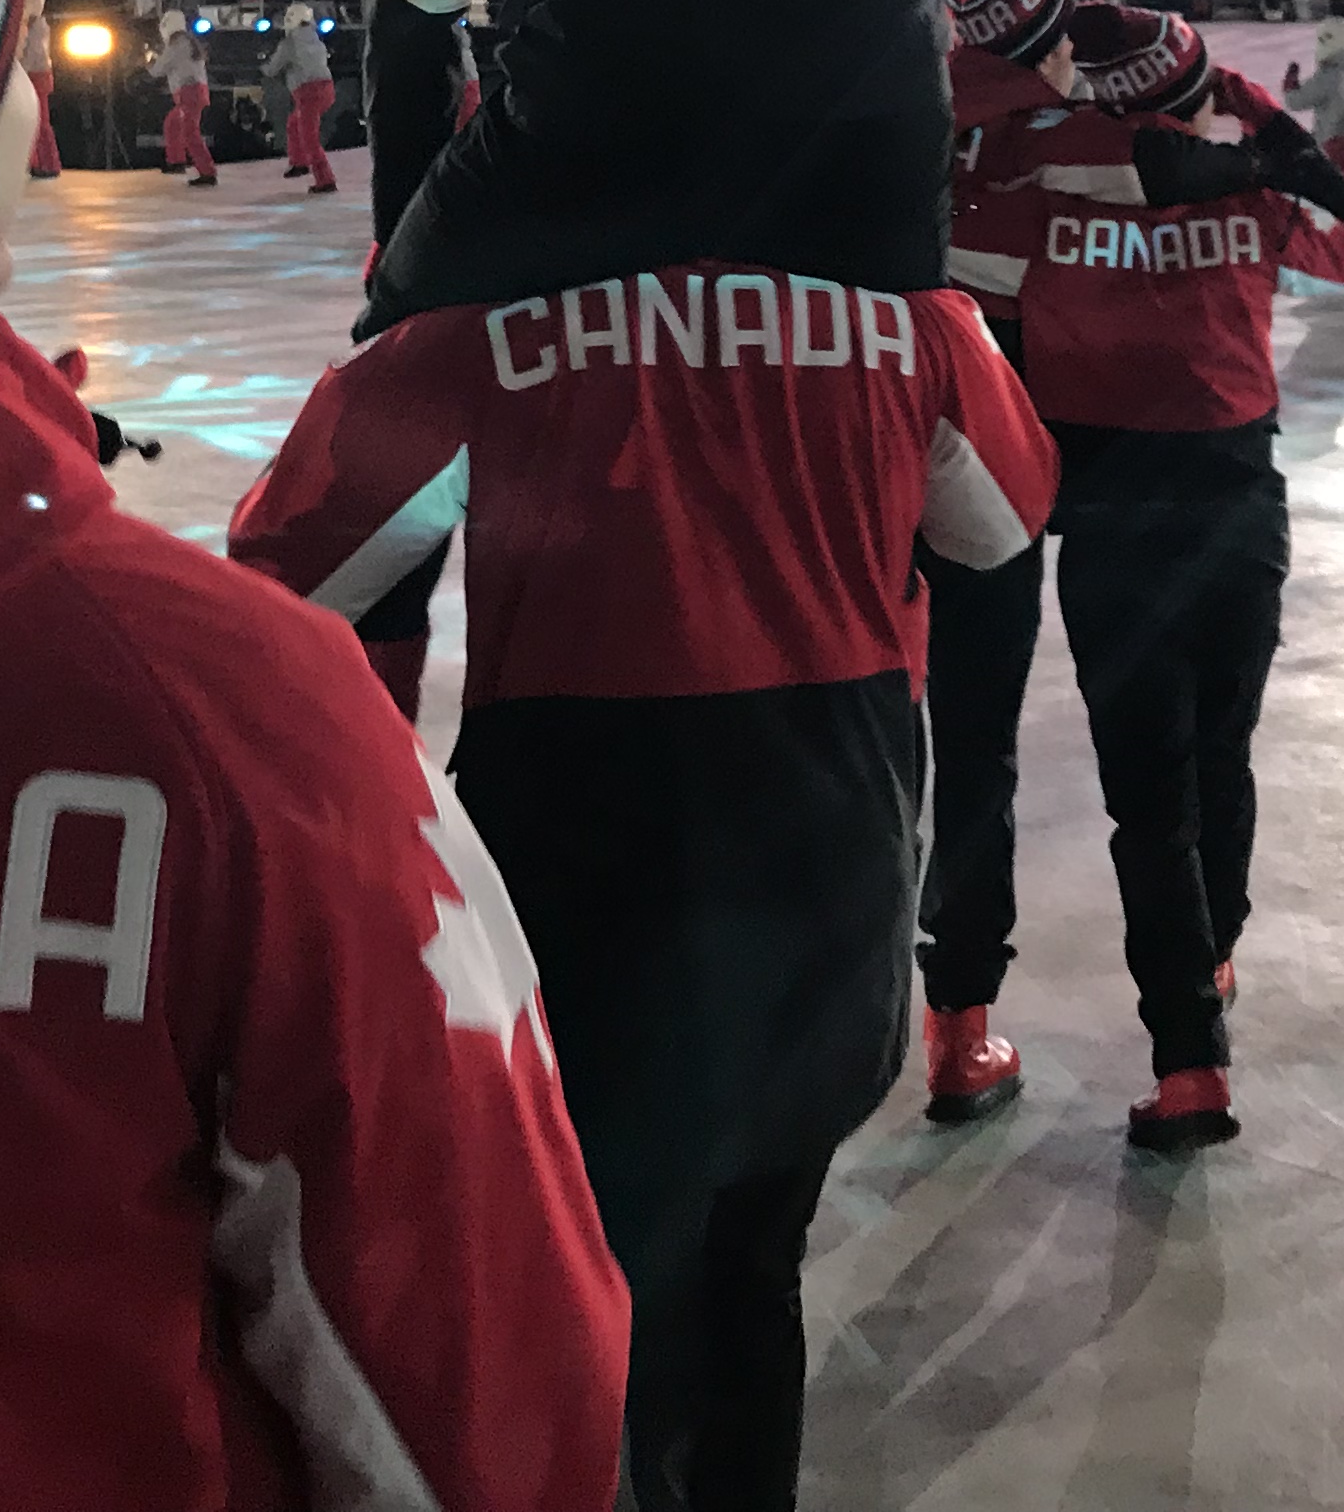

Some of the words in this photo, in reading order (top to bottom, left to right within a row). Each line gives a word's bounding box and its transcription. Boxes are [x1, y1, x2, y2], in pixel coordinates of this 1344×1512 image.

[1094, 45, 1179, 101] ADA
[1047, 215, 1262, 274] CANADA
[486, 273, 916, 392] CANADA
